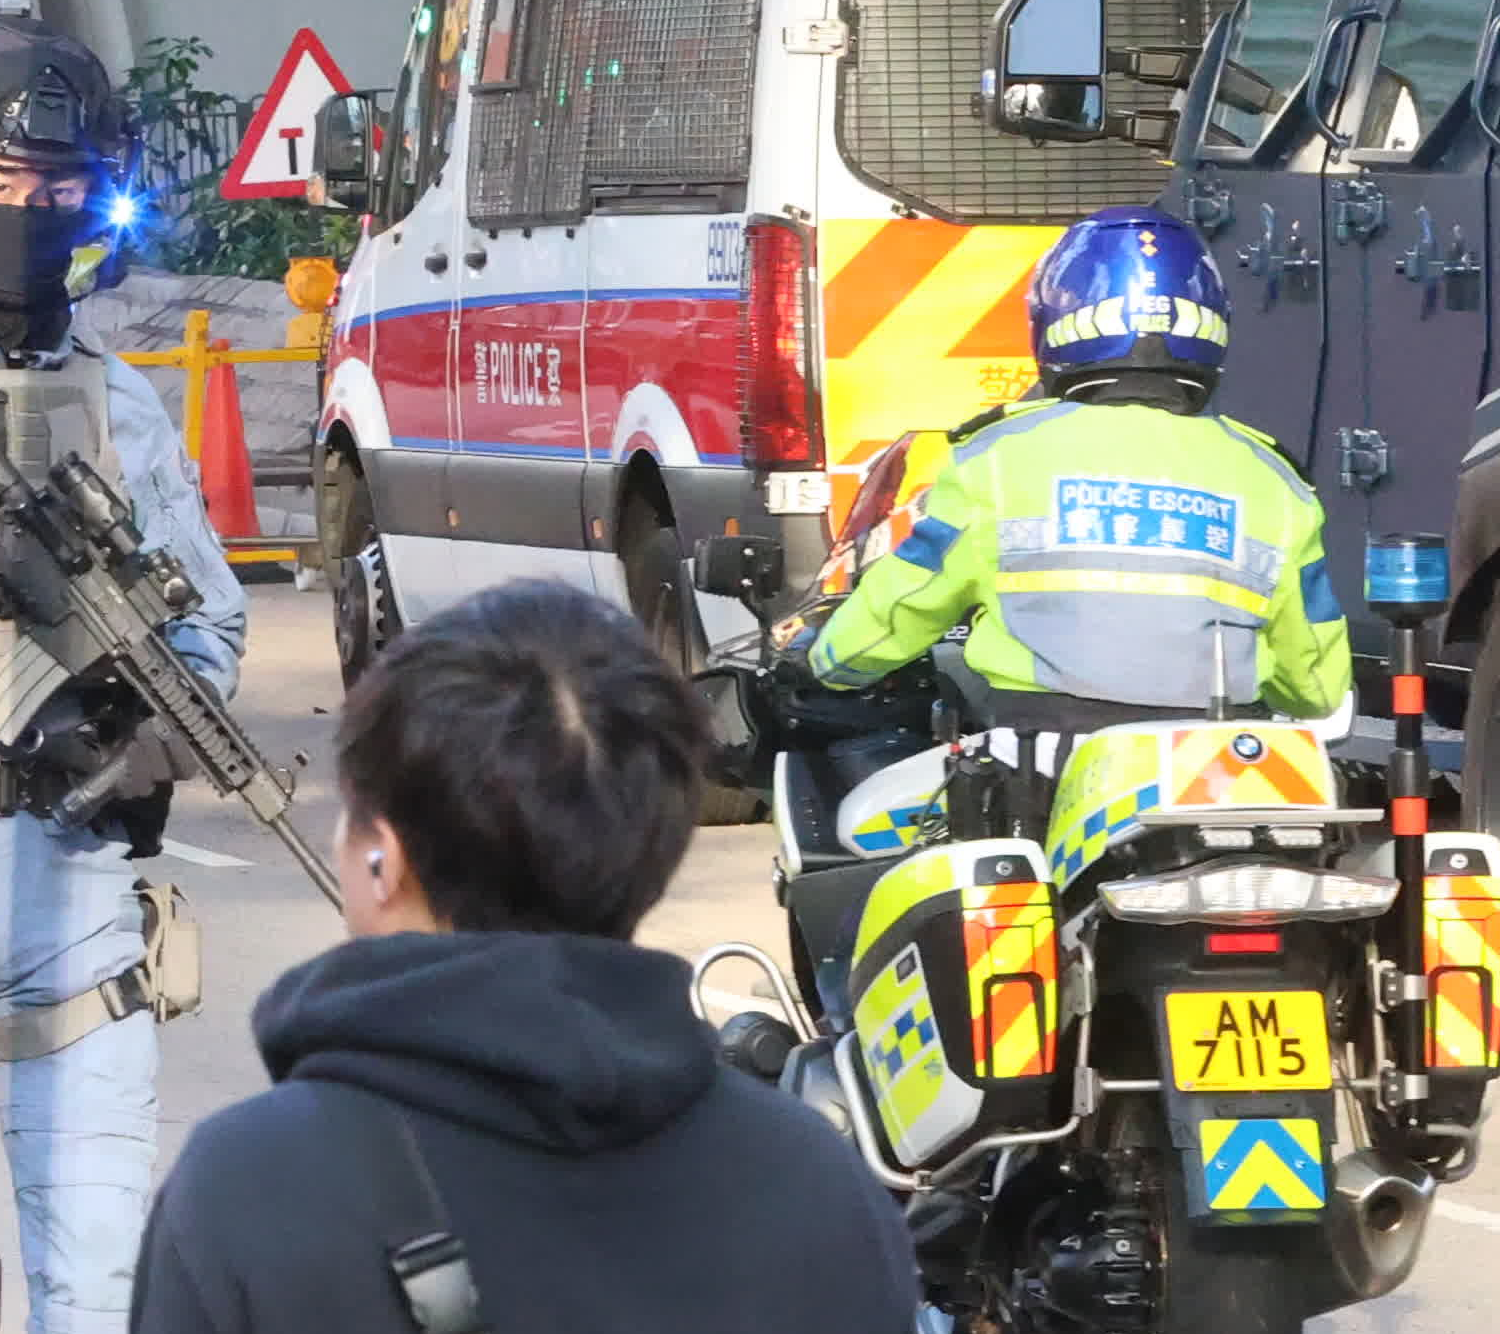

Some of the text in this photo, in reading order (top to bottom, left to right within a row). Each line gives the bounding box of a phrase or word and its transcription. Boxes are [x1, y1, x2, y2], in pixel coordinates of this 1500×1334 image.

[490, 341, 545, 406] POLICE
[1062, 482, 1232, 523] POLICE ESCORT
[1216, 998, 1279, 1038] AM
[1193, 1038, 1306, 1078] 7115
